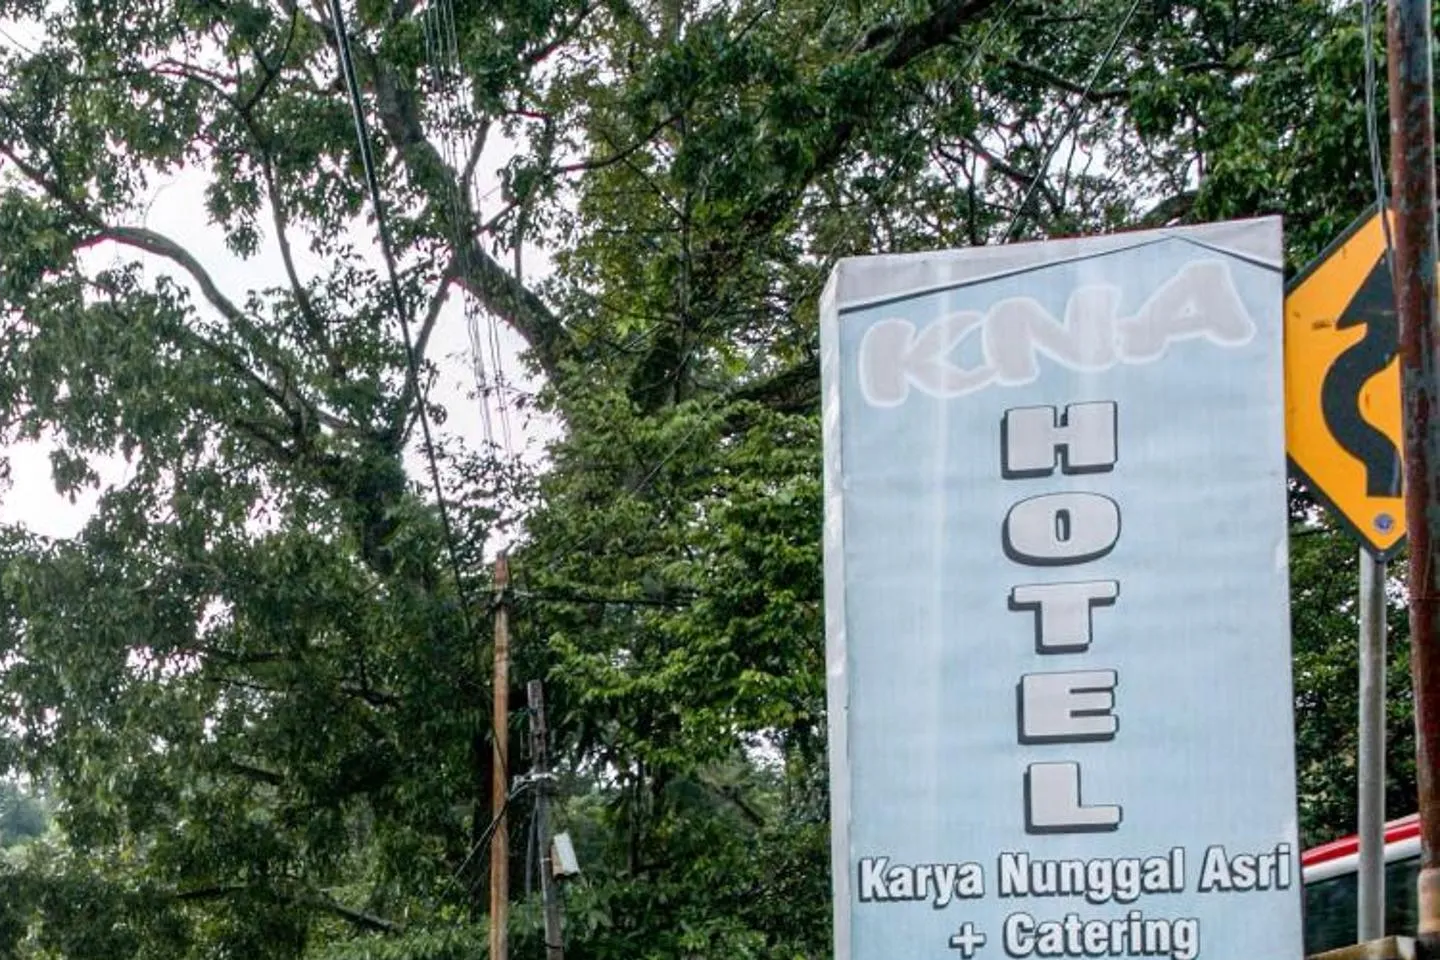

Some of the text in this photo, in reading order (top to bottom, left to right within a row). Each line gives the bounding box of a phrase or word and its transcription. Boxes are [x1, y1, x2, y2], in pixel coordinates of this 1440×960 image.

[859, 258, 1257, 408] KNA
[1000, 400, 1123, 834] HOTEL
[858, 843, 1291, 909] Karya Nunggal Asri
